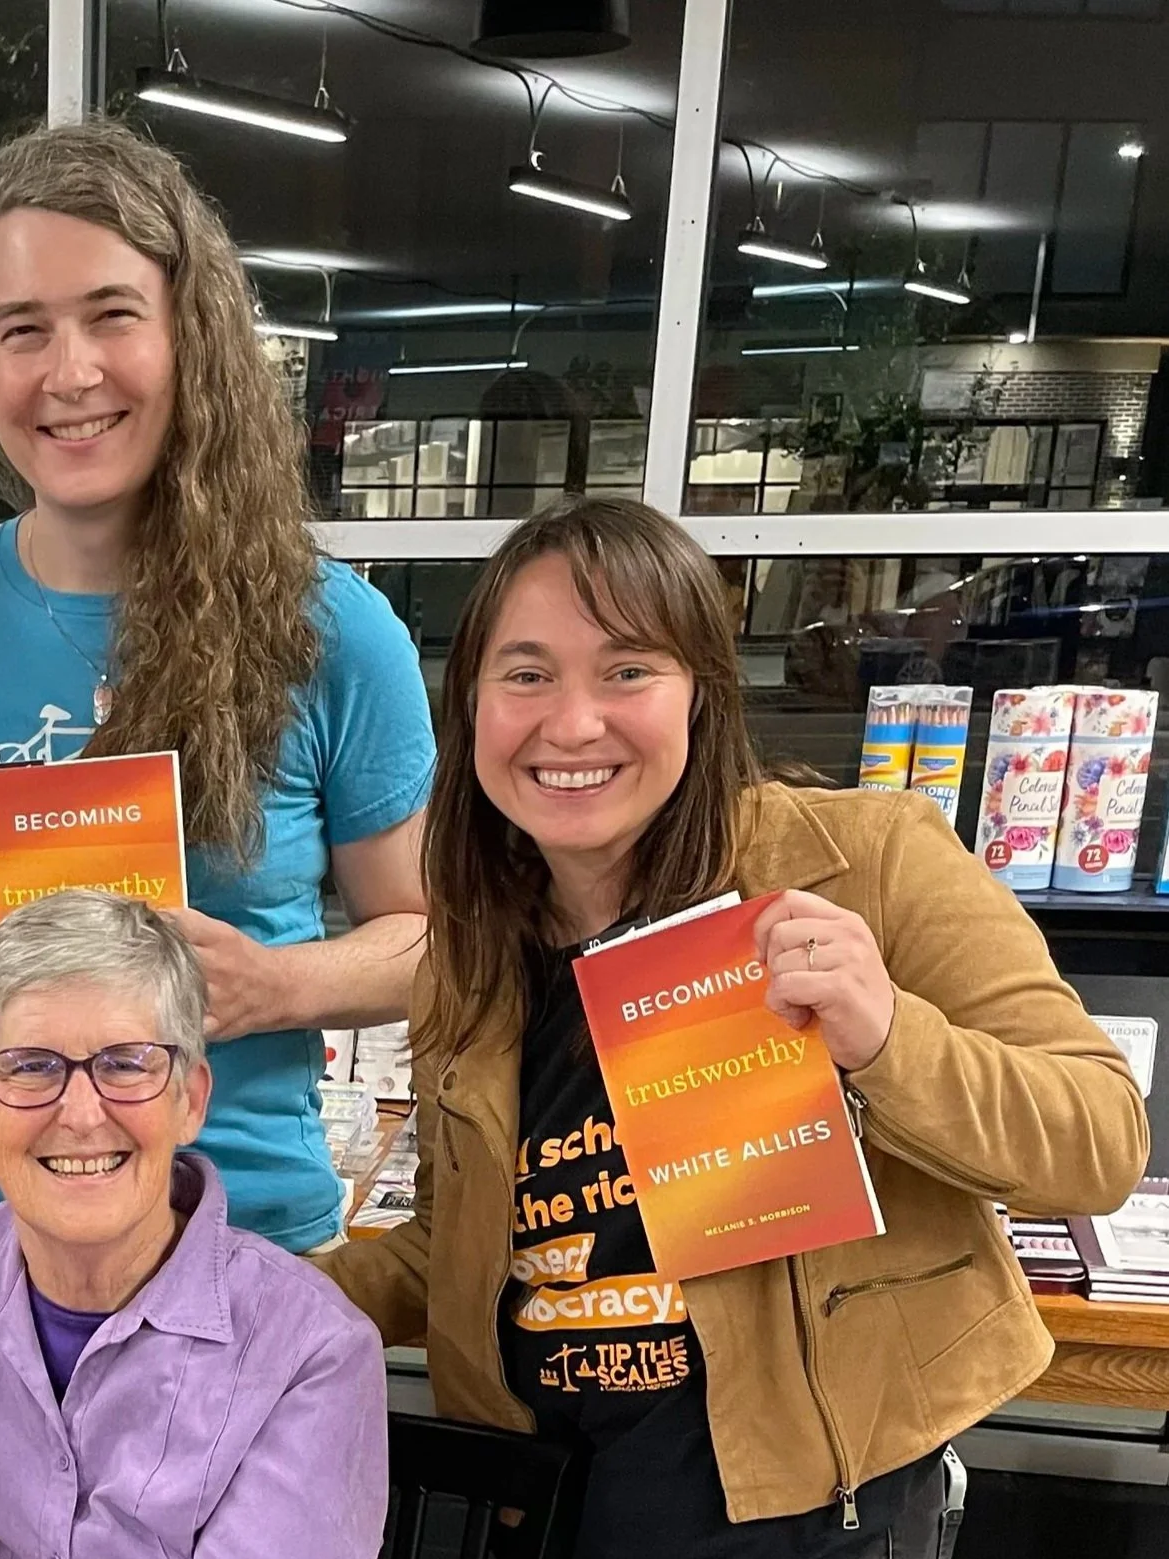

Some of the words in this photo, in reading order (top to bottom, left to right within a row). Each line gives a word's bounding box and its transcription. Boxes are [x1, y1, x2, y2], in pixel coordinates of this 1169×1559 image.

[14, 804, 142, 832] BECOMING
[991, 845, 1004, 858] 72
[1086, 848, 1101, 861] 72
[621, 961, 764, 1023] BECOMING
[624, 1034, 808, 1108] trustworthy
[647, 1148, 730, 1185] WHITE
[742, 1120, 833, 1162] ALLIES
[582, 1170, 637, 1214] ric
[704, 1220, 745, 1237] MELANIE
[748, 1218, 757, 1226] S.
[759, 1204, 811, 1223] MORRISON
[595, 1343, 632, 1367] TIP
[636, 1334, 688, 1365] THE
[596, 1356, 690, 1386] SCALES
